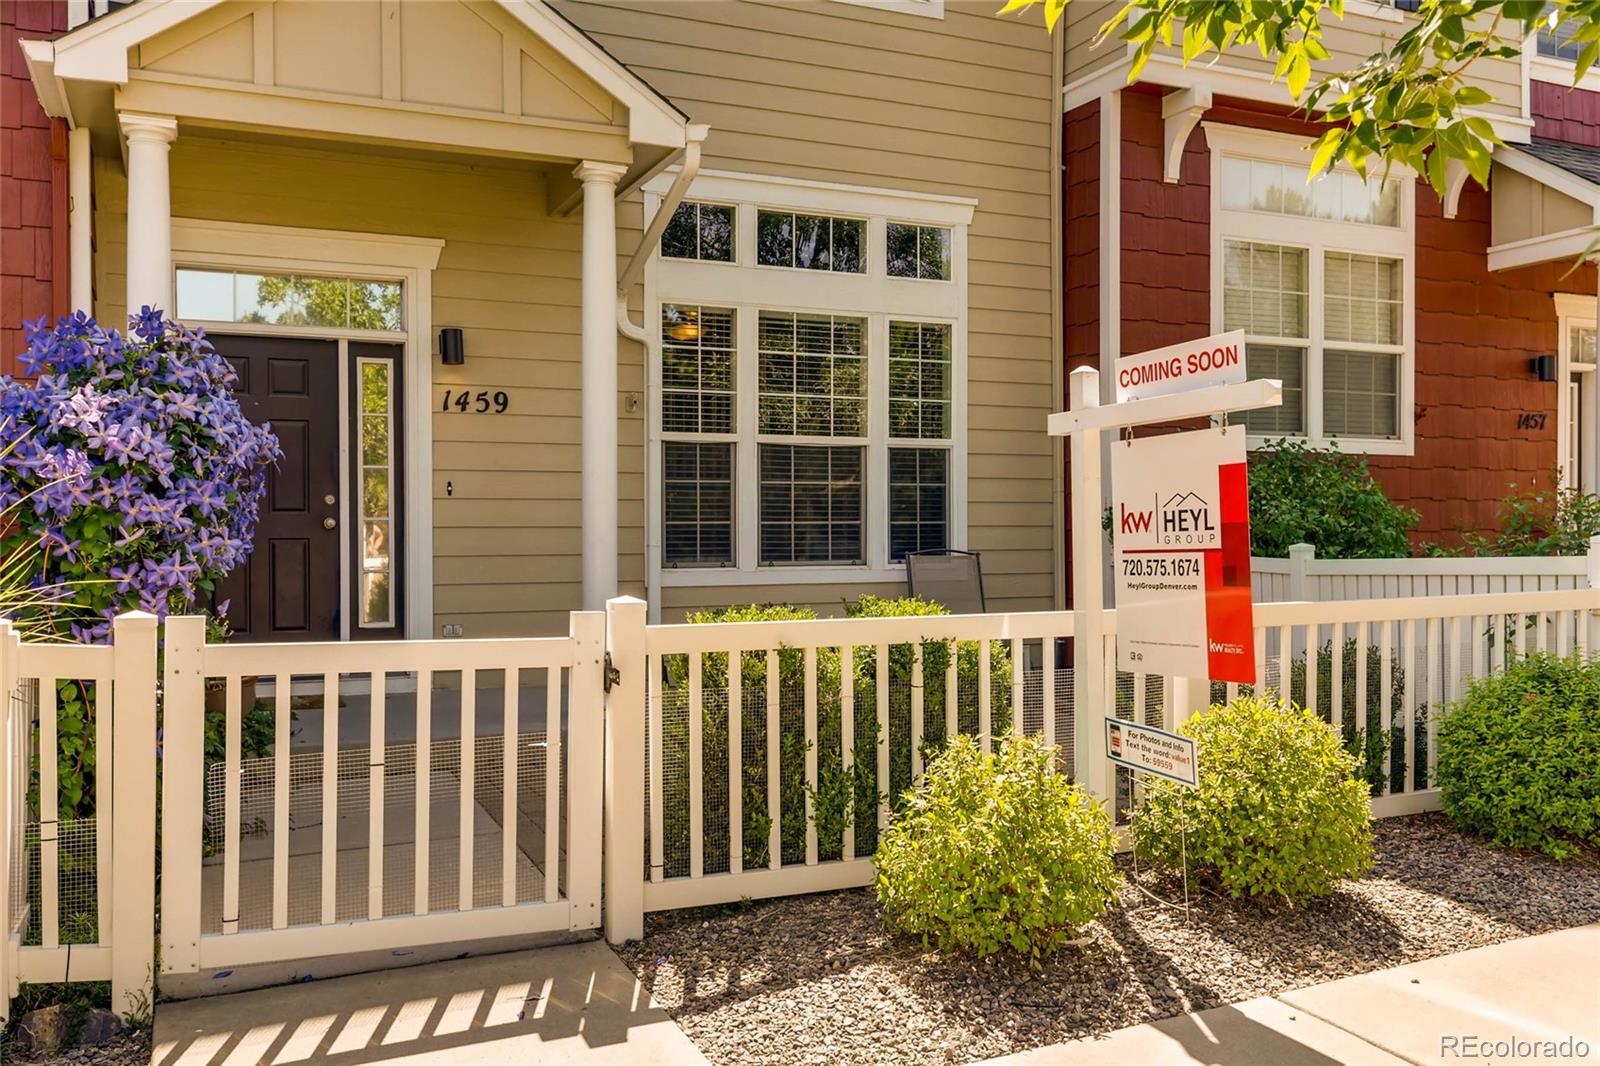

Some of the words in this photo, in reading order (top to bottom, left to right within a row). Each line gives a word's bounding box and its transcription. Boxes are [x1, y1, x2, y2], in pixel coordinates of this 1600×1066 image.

[1119, 358, 1182, 388] COMING
[1187, 345, 1238, 375] SOON
[443, 390, 509, 413] 1459
[1517, 414, 1547, 430] 1457
[1121, 502, 1153, 534] kw
[1163, 508, 1215, 532] HEYL
[1164, 534, 1216, 544] GROUP
[1122, 559, 1200, 576] 720.575.1674
[1127, 582, 1198, 591] HeylGroupDenver.com
[1208, 638, 1224, 653] kw
[1125, 740, 1140, 750] Text
[1141, 744, 1151, 753] the
[1153, 748, 1170, 758] word:
[1128, 730, 1138, 739] For
[1139, 733, 1160, 746] Photos
[1161, 741, 1172, 749] and
[1173, 743, 1184, 752] Info
[1141, 754, 1151, 763] To:
[1152, 758, 1173, 770] 59559
